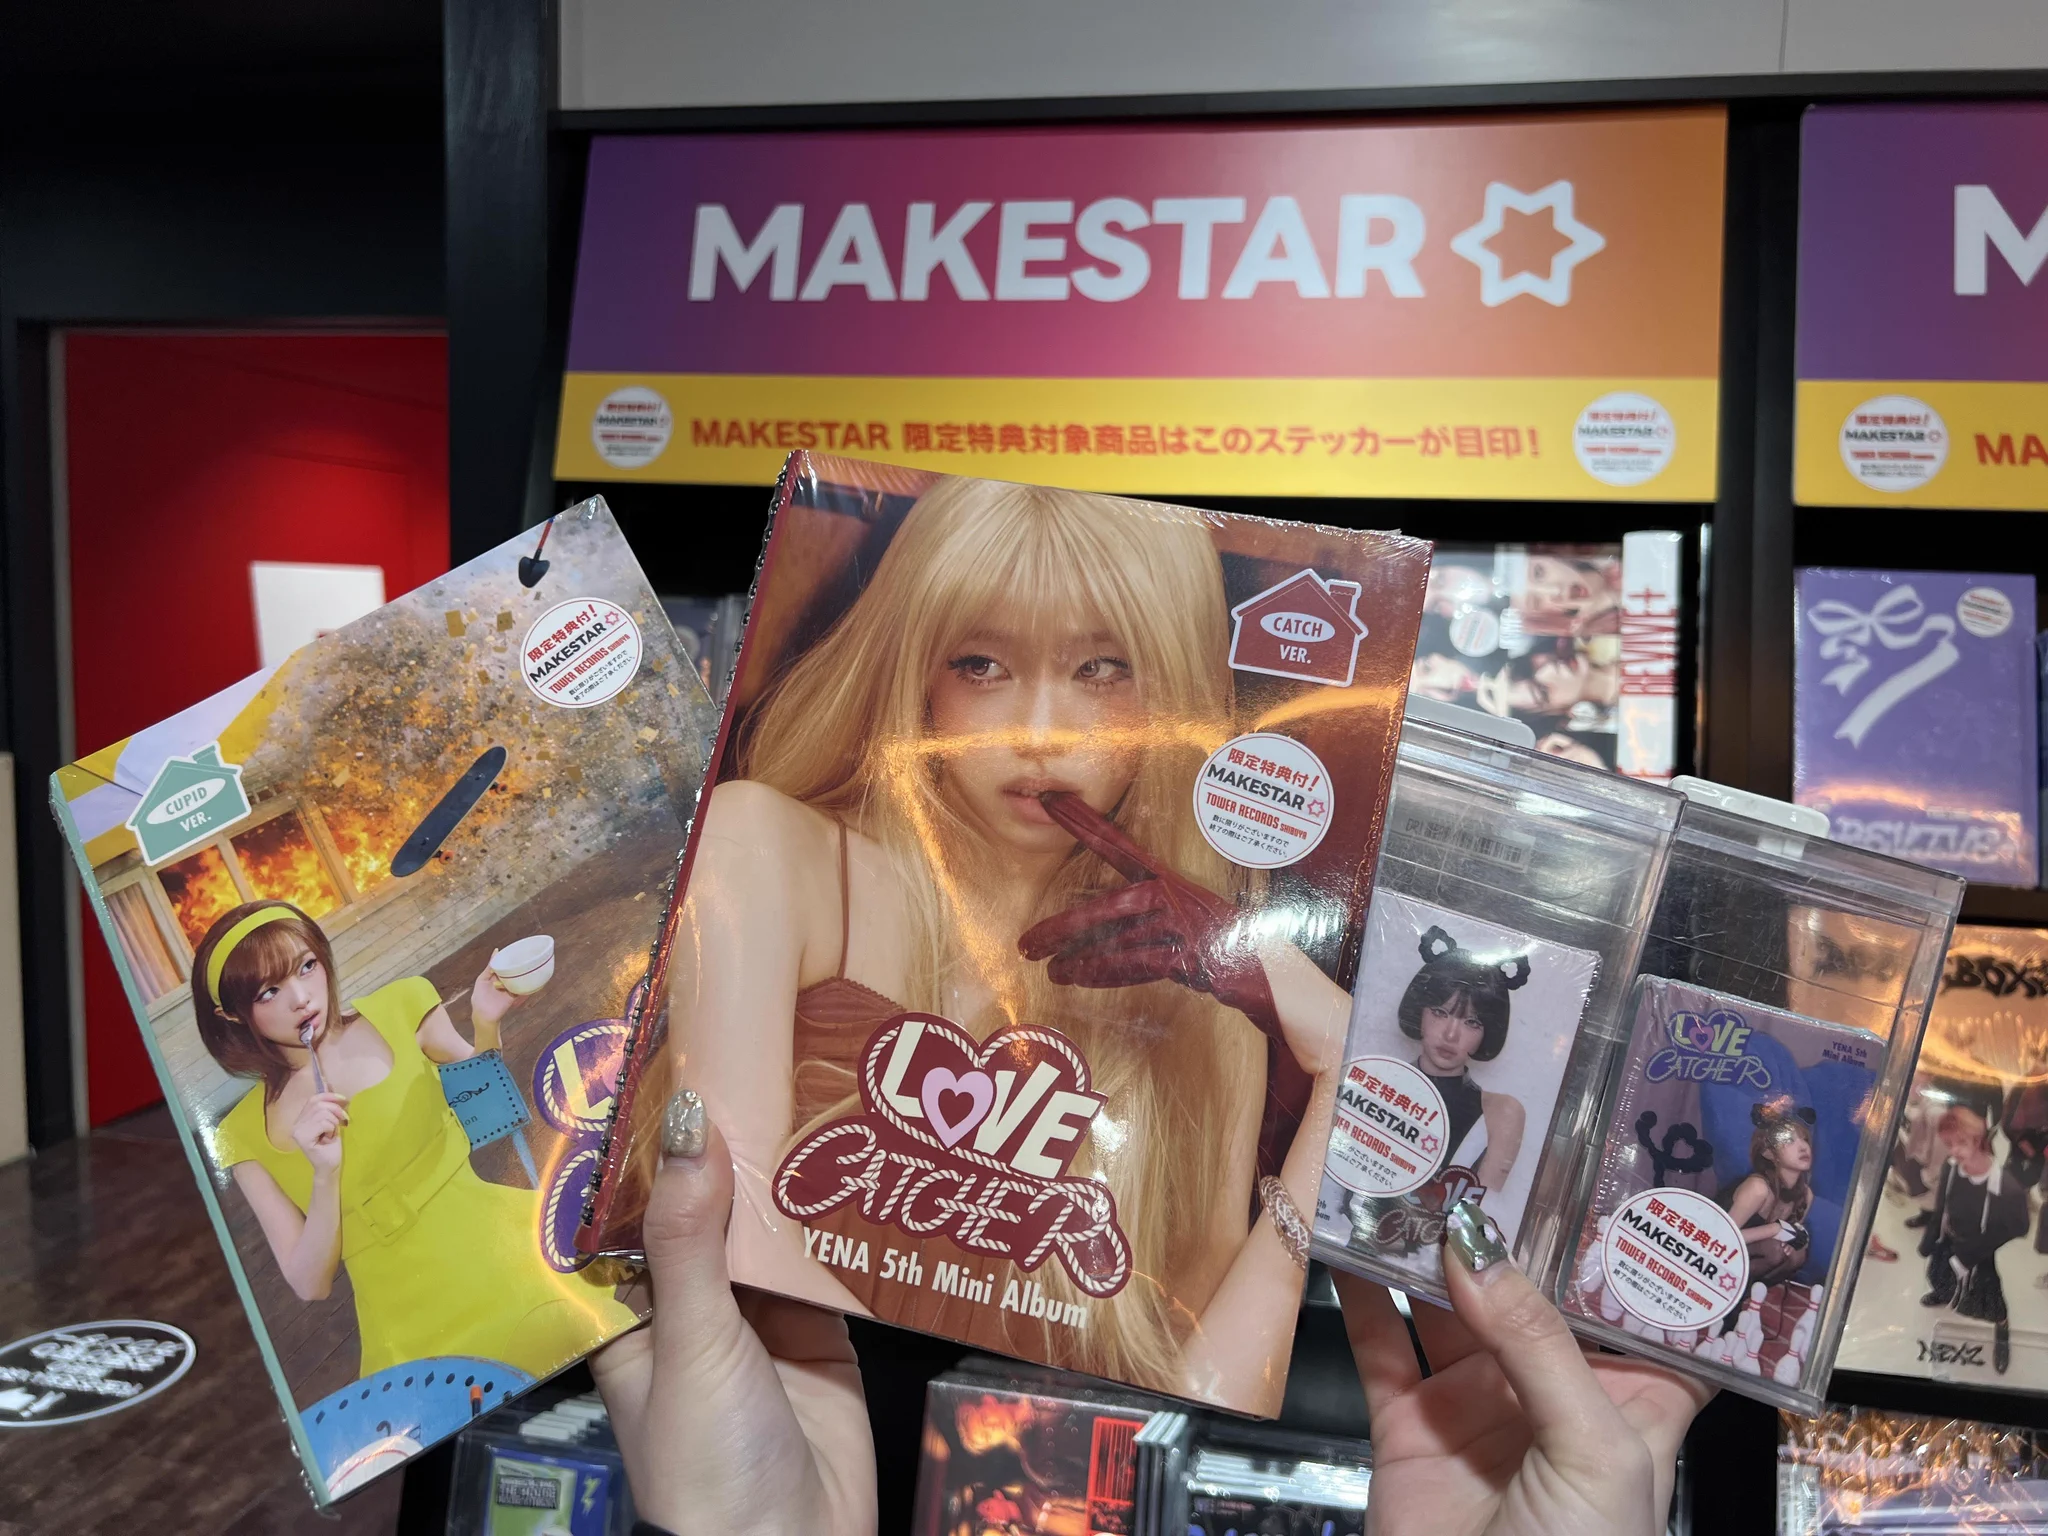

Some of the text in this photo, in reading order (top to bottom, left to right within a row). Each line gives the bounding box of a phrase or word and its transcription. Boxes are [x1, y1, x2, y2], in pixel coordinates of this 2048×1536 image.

[688, 194, 1425, 302] MAKESTAR
[691, 419, 890, 450] MAKESTAR
[1974, 433, 2048, 467] MA
[527, 604, 597, 663] 限定特典付!
[1273, 616, 1323, 638] CATCH
[529, 622, 606, 683] MAKESTAR
[548, 671, 577, 694] TOWER
[574, 647, 609, 675] RECORDS
[1279, 644, 1312, 664] VER.
[1207, 764, 1305, 811] MAKESTAR
[1227, 748, 1320, 792] 限定特典付!
[165, 787, 207, 815] CUPID
[180, 811, 212, 832] VER.
[1206, 792, 1236, 813] TOWER
[1238, 804, 1280, 829] RECORDS
[1674, 1014, 1751, 1057] LOVE
[1646, 1050, 1772, 1090] CATCHER
[880, 1021, 1101, 1180] LOVE
[1348, 1065, 1438, 1127] 限定特典付!
[1351, 1125, 1391, 1158] RECORDS
[779, 1124, 1126, 1293] CATCHER
[1646, 1197, 1738, 1264] 限定特典付!
[1615, 1236, 1646, 1264] TOWER
[1646, 1257, 1688, 1291] RECORDS
[1622, 1209, 1718, 1280] MAKESTAR
[801, 1226, 1088, 1329] YENA 5th Mini Album
